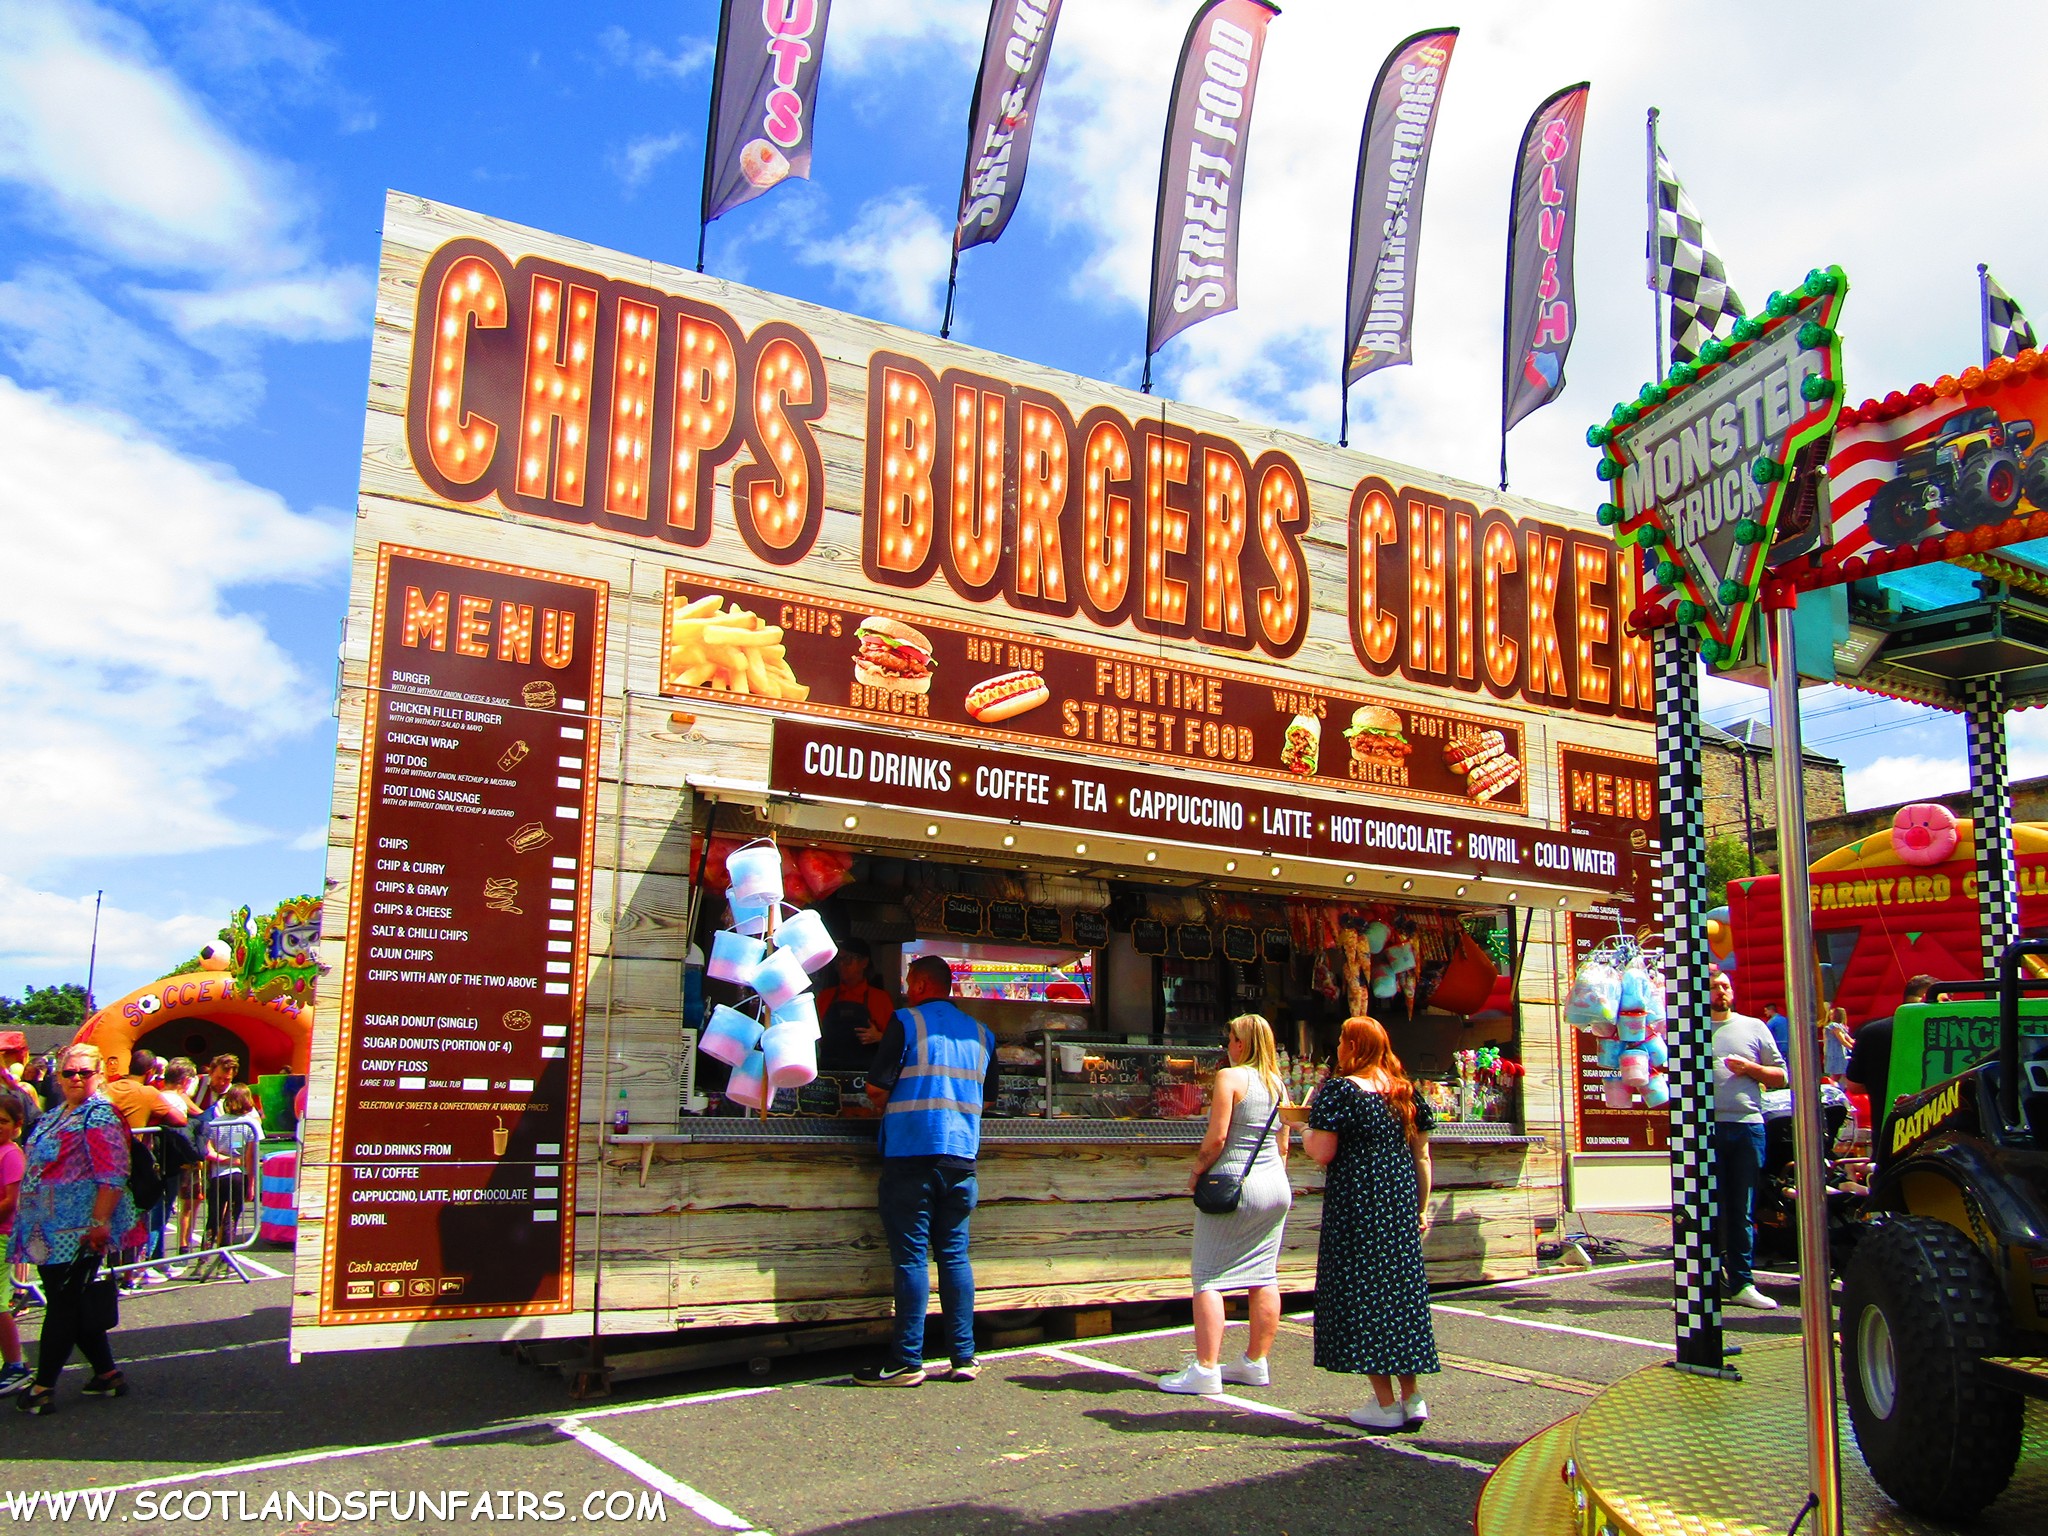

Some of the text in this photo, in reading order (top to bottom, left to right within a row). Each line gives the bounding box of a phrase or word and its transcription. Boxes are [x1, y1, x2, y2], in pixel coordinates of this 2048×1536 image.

[1173, 18, 1253, 314] STREET FOOD
[427, 255, 813, 549] CHIPS
[877, 366, 1299, 645] BURGERS
[401, 585, 575, 669] MENU
[780, 604, 842, 638] CHIPS
[967, 637, 1045, 672] HOT DOG
[392, 671, 430, 685] BURGER
[1096, 659, 1223, 715] FUNTIME
[850, 681, 929, 717] BURGER
[1272, 690, 1327, 719] WRAPS
[390, 701, 502, 724] CHICKEN FILLET BURGER
[389, 714, 405, 723] WITH
[415, 717, 440, 727] WITHOUT
[440, 720, 460, 729] SALAD
[467, 724, 483, 732] MAYO
[1062, 699, 1253, 762] STREET FOOD
[1411, 714, 1443, 739] FOOT
[388, 732, 459, 750] CHICKEN WRAP
[386, 753, 428, 768] HOT DOG
[385, 767, 401, 775] WITH
[401, 768, 410, 776] OR
[410, 769, 437, 778] WITHOUT
[458, 774, 484, 784] KETCHUP
[490, 778, 517, 788] MUSTARD
[1349, 760, 1409, 787] CHICKEN
[383, 784, 481, 805] FOOT LONG SAUSAGE
[1571, 770, 1652, 821] MENU
[382, 798, 399, 806] WITH
[408, 800, 435, 810] WITHOUT
[455, 805, 482, 815] KETCHUP
[488, 808, 515, 818] MUSTARD
[804, 742, 1615, 877] COLD DRINKS COFFEE TEA CAPPUCCINO LATTE HOT CHOCOLATE BOVRIL COLD WATER
[379, 837, 409, 850] CHIPS
[377, 858, 446, 875] CHIP & CURRY
[375, 881, 449, 897] CHIPS & GRAVY
[1810, 874, 1950, 911] FARMYARD
[374, 903, 453, 919] CHIPS & CHEESE
[948, 900, 979, 914] SLUSH
[372, 925, 469, 942] SALT & CHILLI CHIPS
[1577, 939, 1591, 947] CHIPS
[370, 947, 434, 962] CAJUN CHIPS
[368, 969, 538, 989] CHIPS WITH ANY OF THE TWO ABOVE
[365, 1014, 479, 1031] SUGAR DONUT (SINGLE)
[363, 1037, 513, 1054] SUGAR DONUTS (PORTION OF 4)
[361, 1059, 429, 1072] CANDY FLOSS
[1582, 1055, 1598, 1063] SUGAR
[360, 1079, 507, 1089] LARGE TUB SMALL TUB BAG
[1583, 1084, 1599, 1092] CANDY
[358, 1101, 549, 1112] SELECTION OF SWEETS & CONFECTIONERY AT VARIOUS PRICES
[1892, 1081, 1959, 1154] BATMAN
[355, 1144, 452, 1155] COLD DRINKS FROM
[353, 1168, 374, 1179] TEA
[381, 1167, 419, 1179] COFFEE
[352, 1189, 528, 1202] CAPPUCCINO, LATTE, HOT CHOCOLATE
[351, 1214, 388, 1226] BOVRIL
[348, 1259, 419, 1274] Cash accepted
[352, 1286, 370, 1294] VISA
